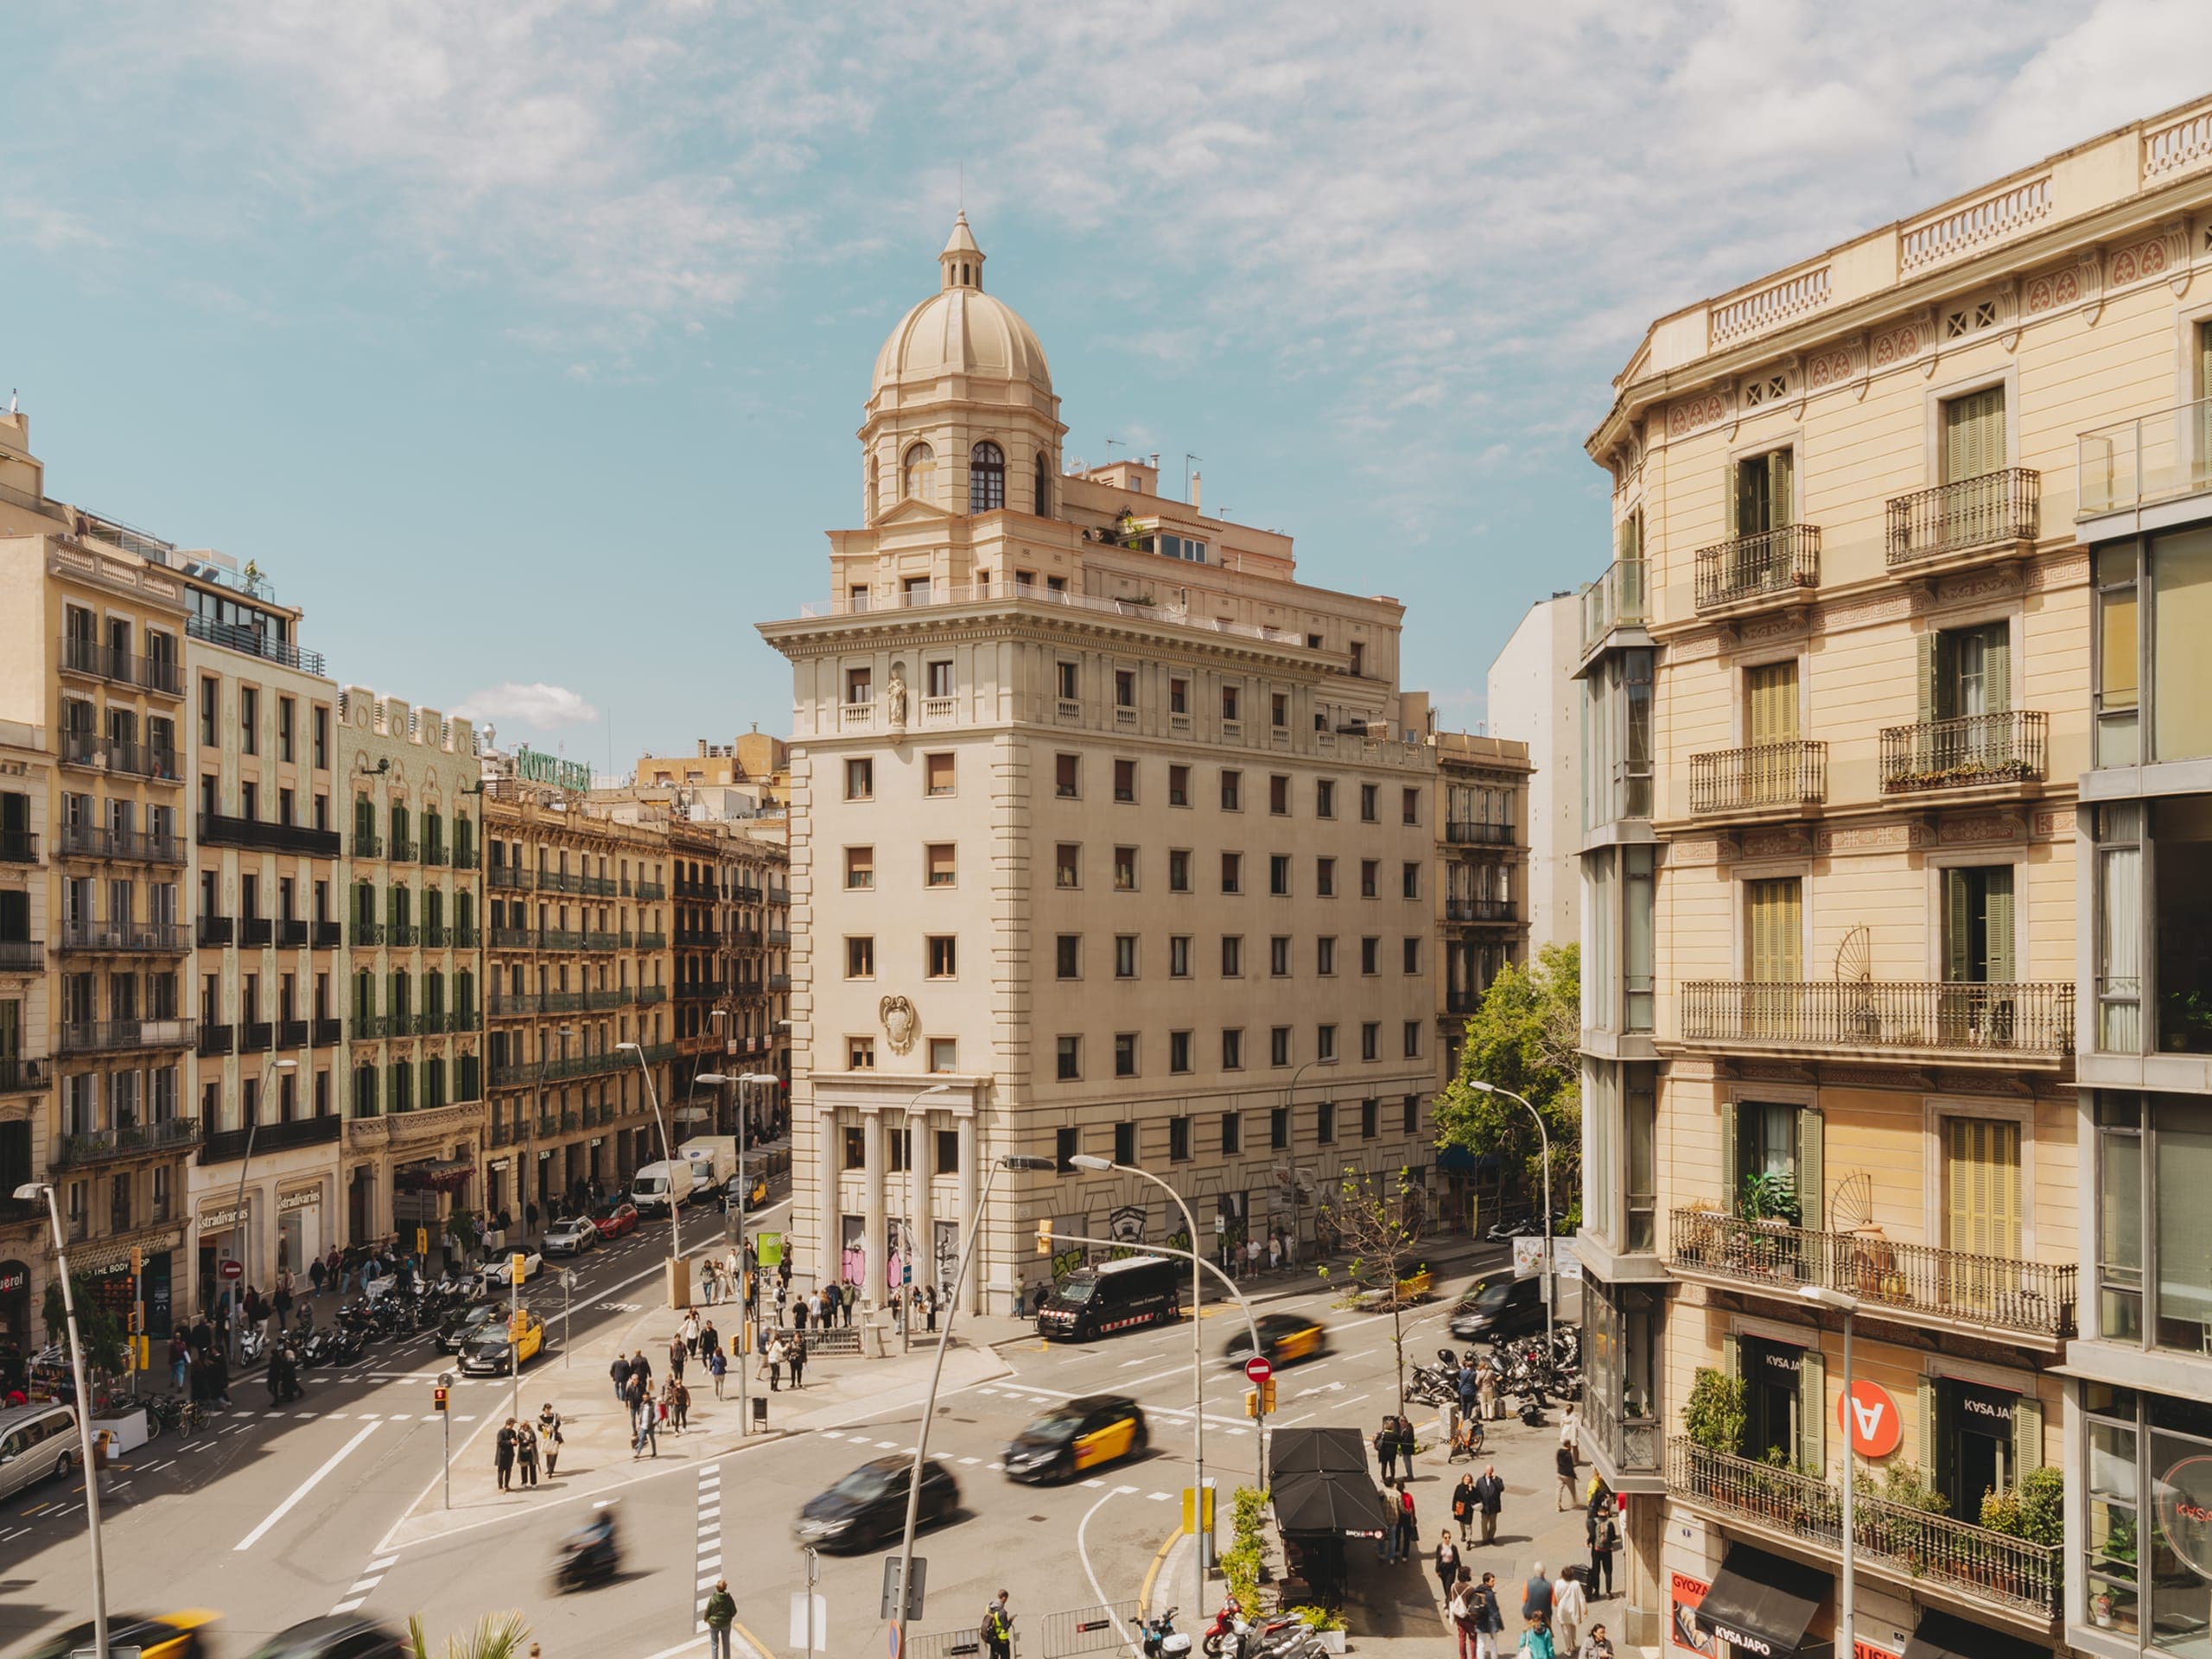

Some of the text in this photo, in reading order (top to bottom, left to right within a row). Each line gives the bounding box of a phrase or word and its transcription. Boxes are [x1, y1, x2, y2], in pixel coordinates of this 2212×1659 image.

[518, 748, 560, 786] HOTEL
[278, 1190, 320, 1210] stradivarius
[200, 1207, 248, 1228] stradivarus
[94, 1266, 108, 1276] THE
[110, 1263, 129, 1274] BODY
[1790, 1360, 1801, 1370] JA
[1743, 1636, 1770, 1656] JAPO
